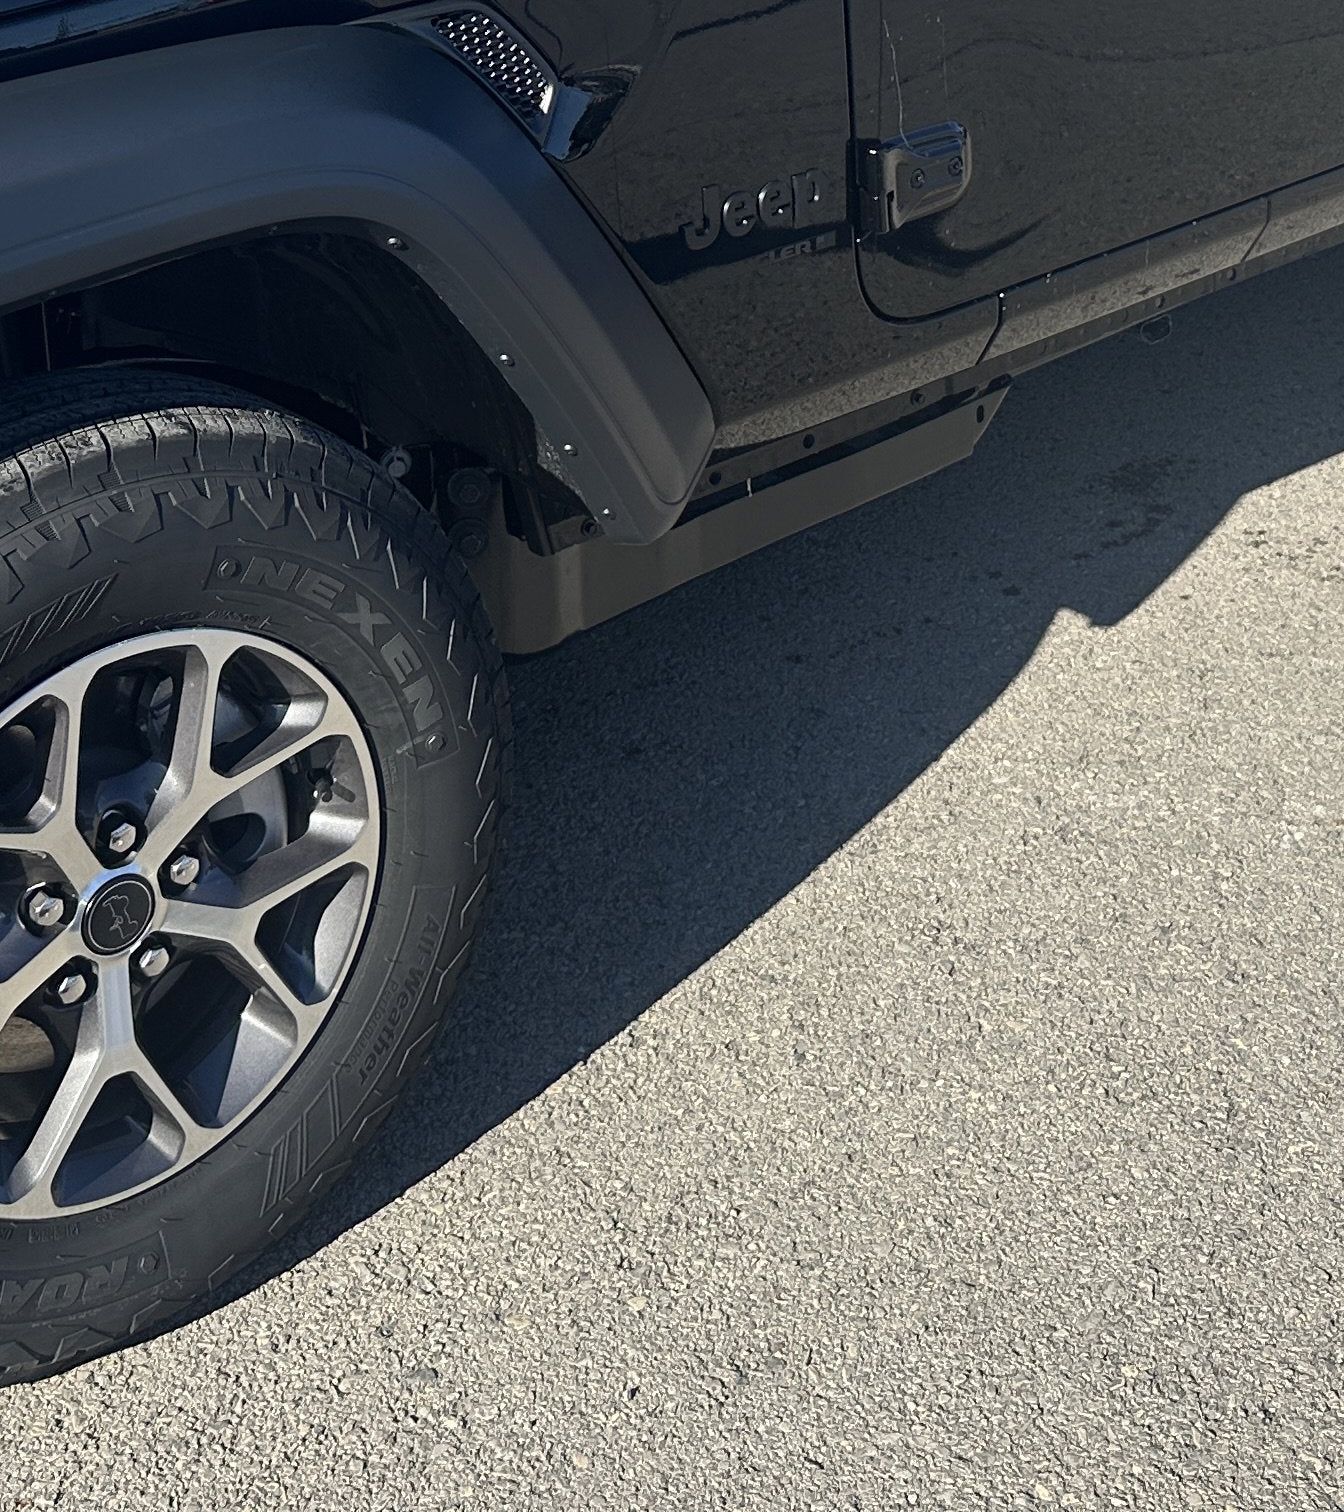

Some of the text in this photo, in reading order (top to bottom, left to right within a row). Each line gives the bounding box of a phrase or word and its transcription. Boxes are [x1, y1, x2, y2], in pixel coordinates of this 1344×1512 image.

[678, 166, 826, 251] Jeep
[239, 554, 444, 733] NEXEN
[353, 912, 445, 1087] All-Weather
